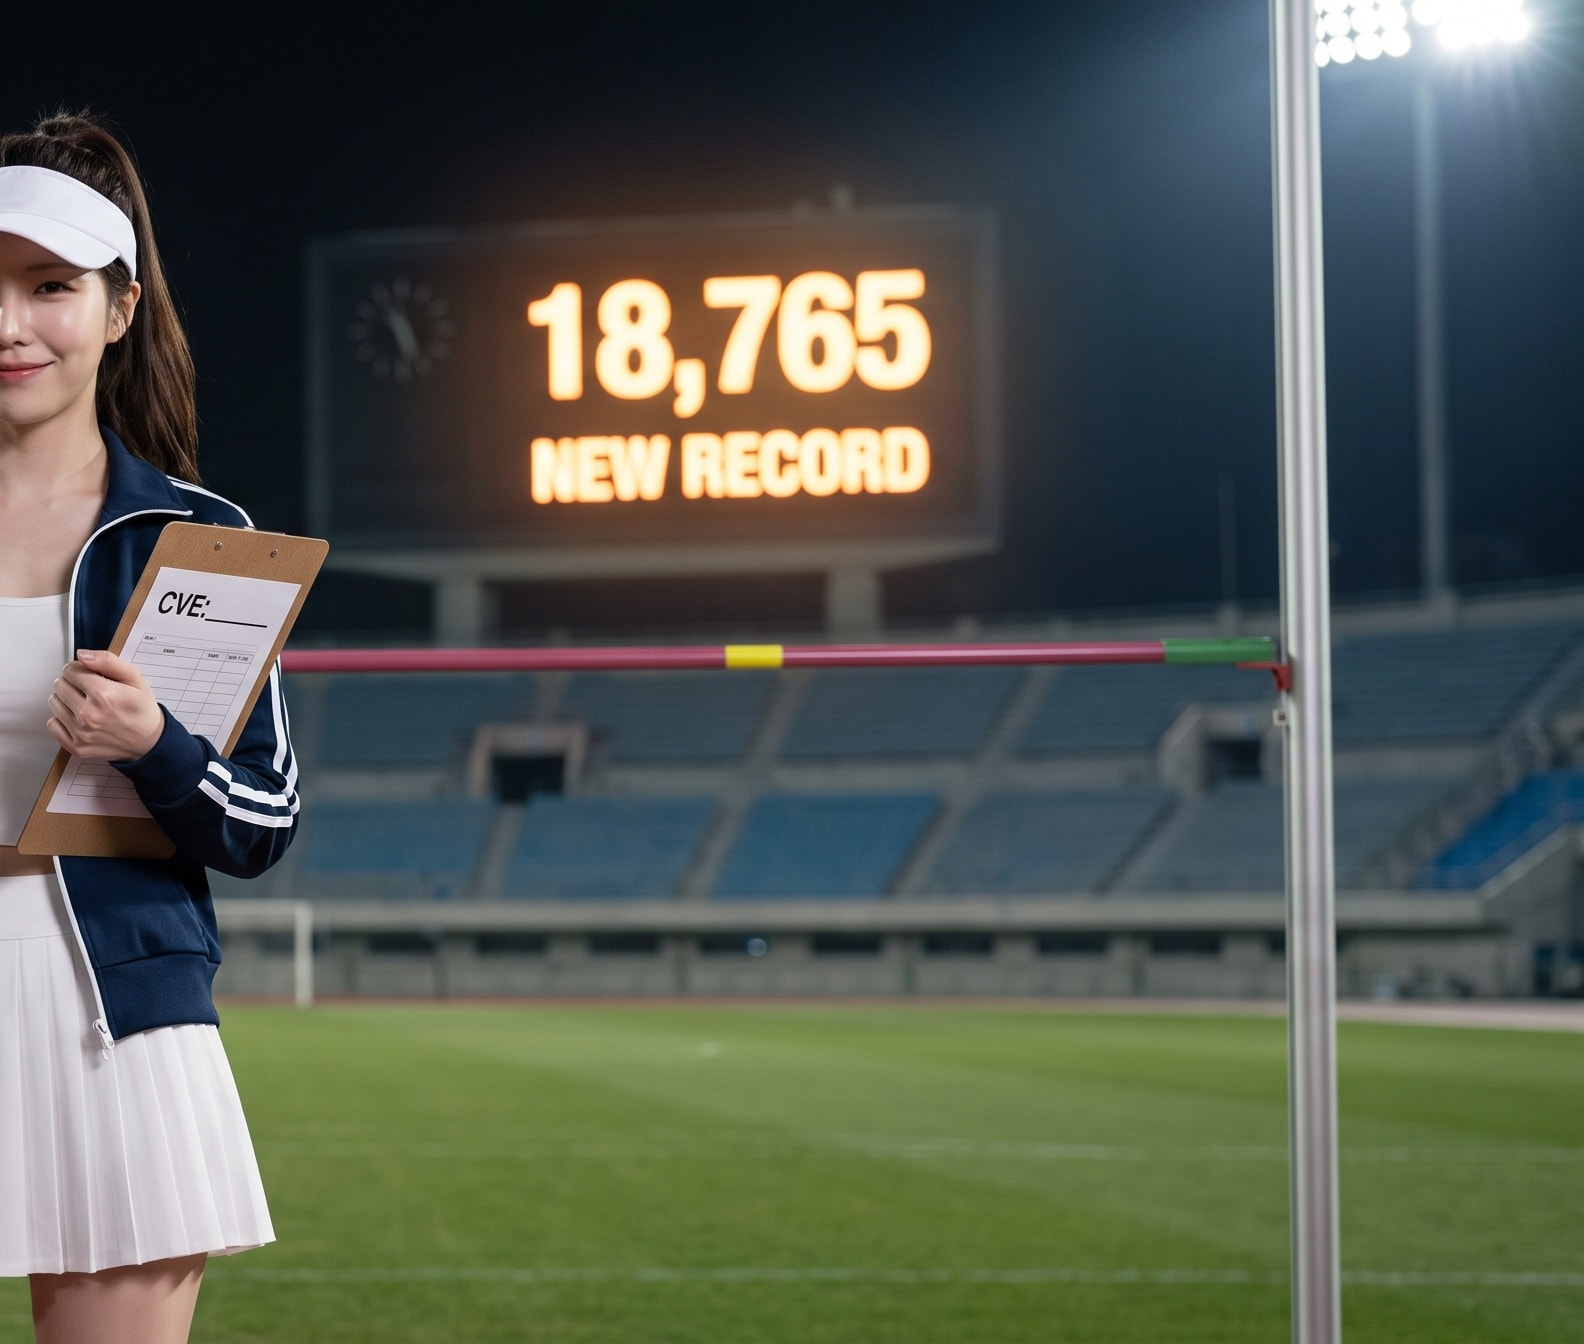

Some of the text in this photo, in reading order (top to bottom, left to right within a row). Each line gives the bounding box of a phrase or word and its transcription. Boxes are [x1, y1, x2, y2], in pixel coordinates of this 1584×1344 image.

[527, 268, 932, 419] 18,765
[530, 426, 931, 504] NEW RECORD
